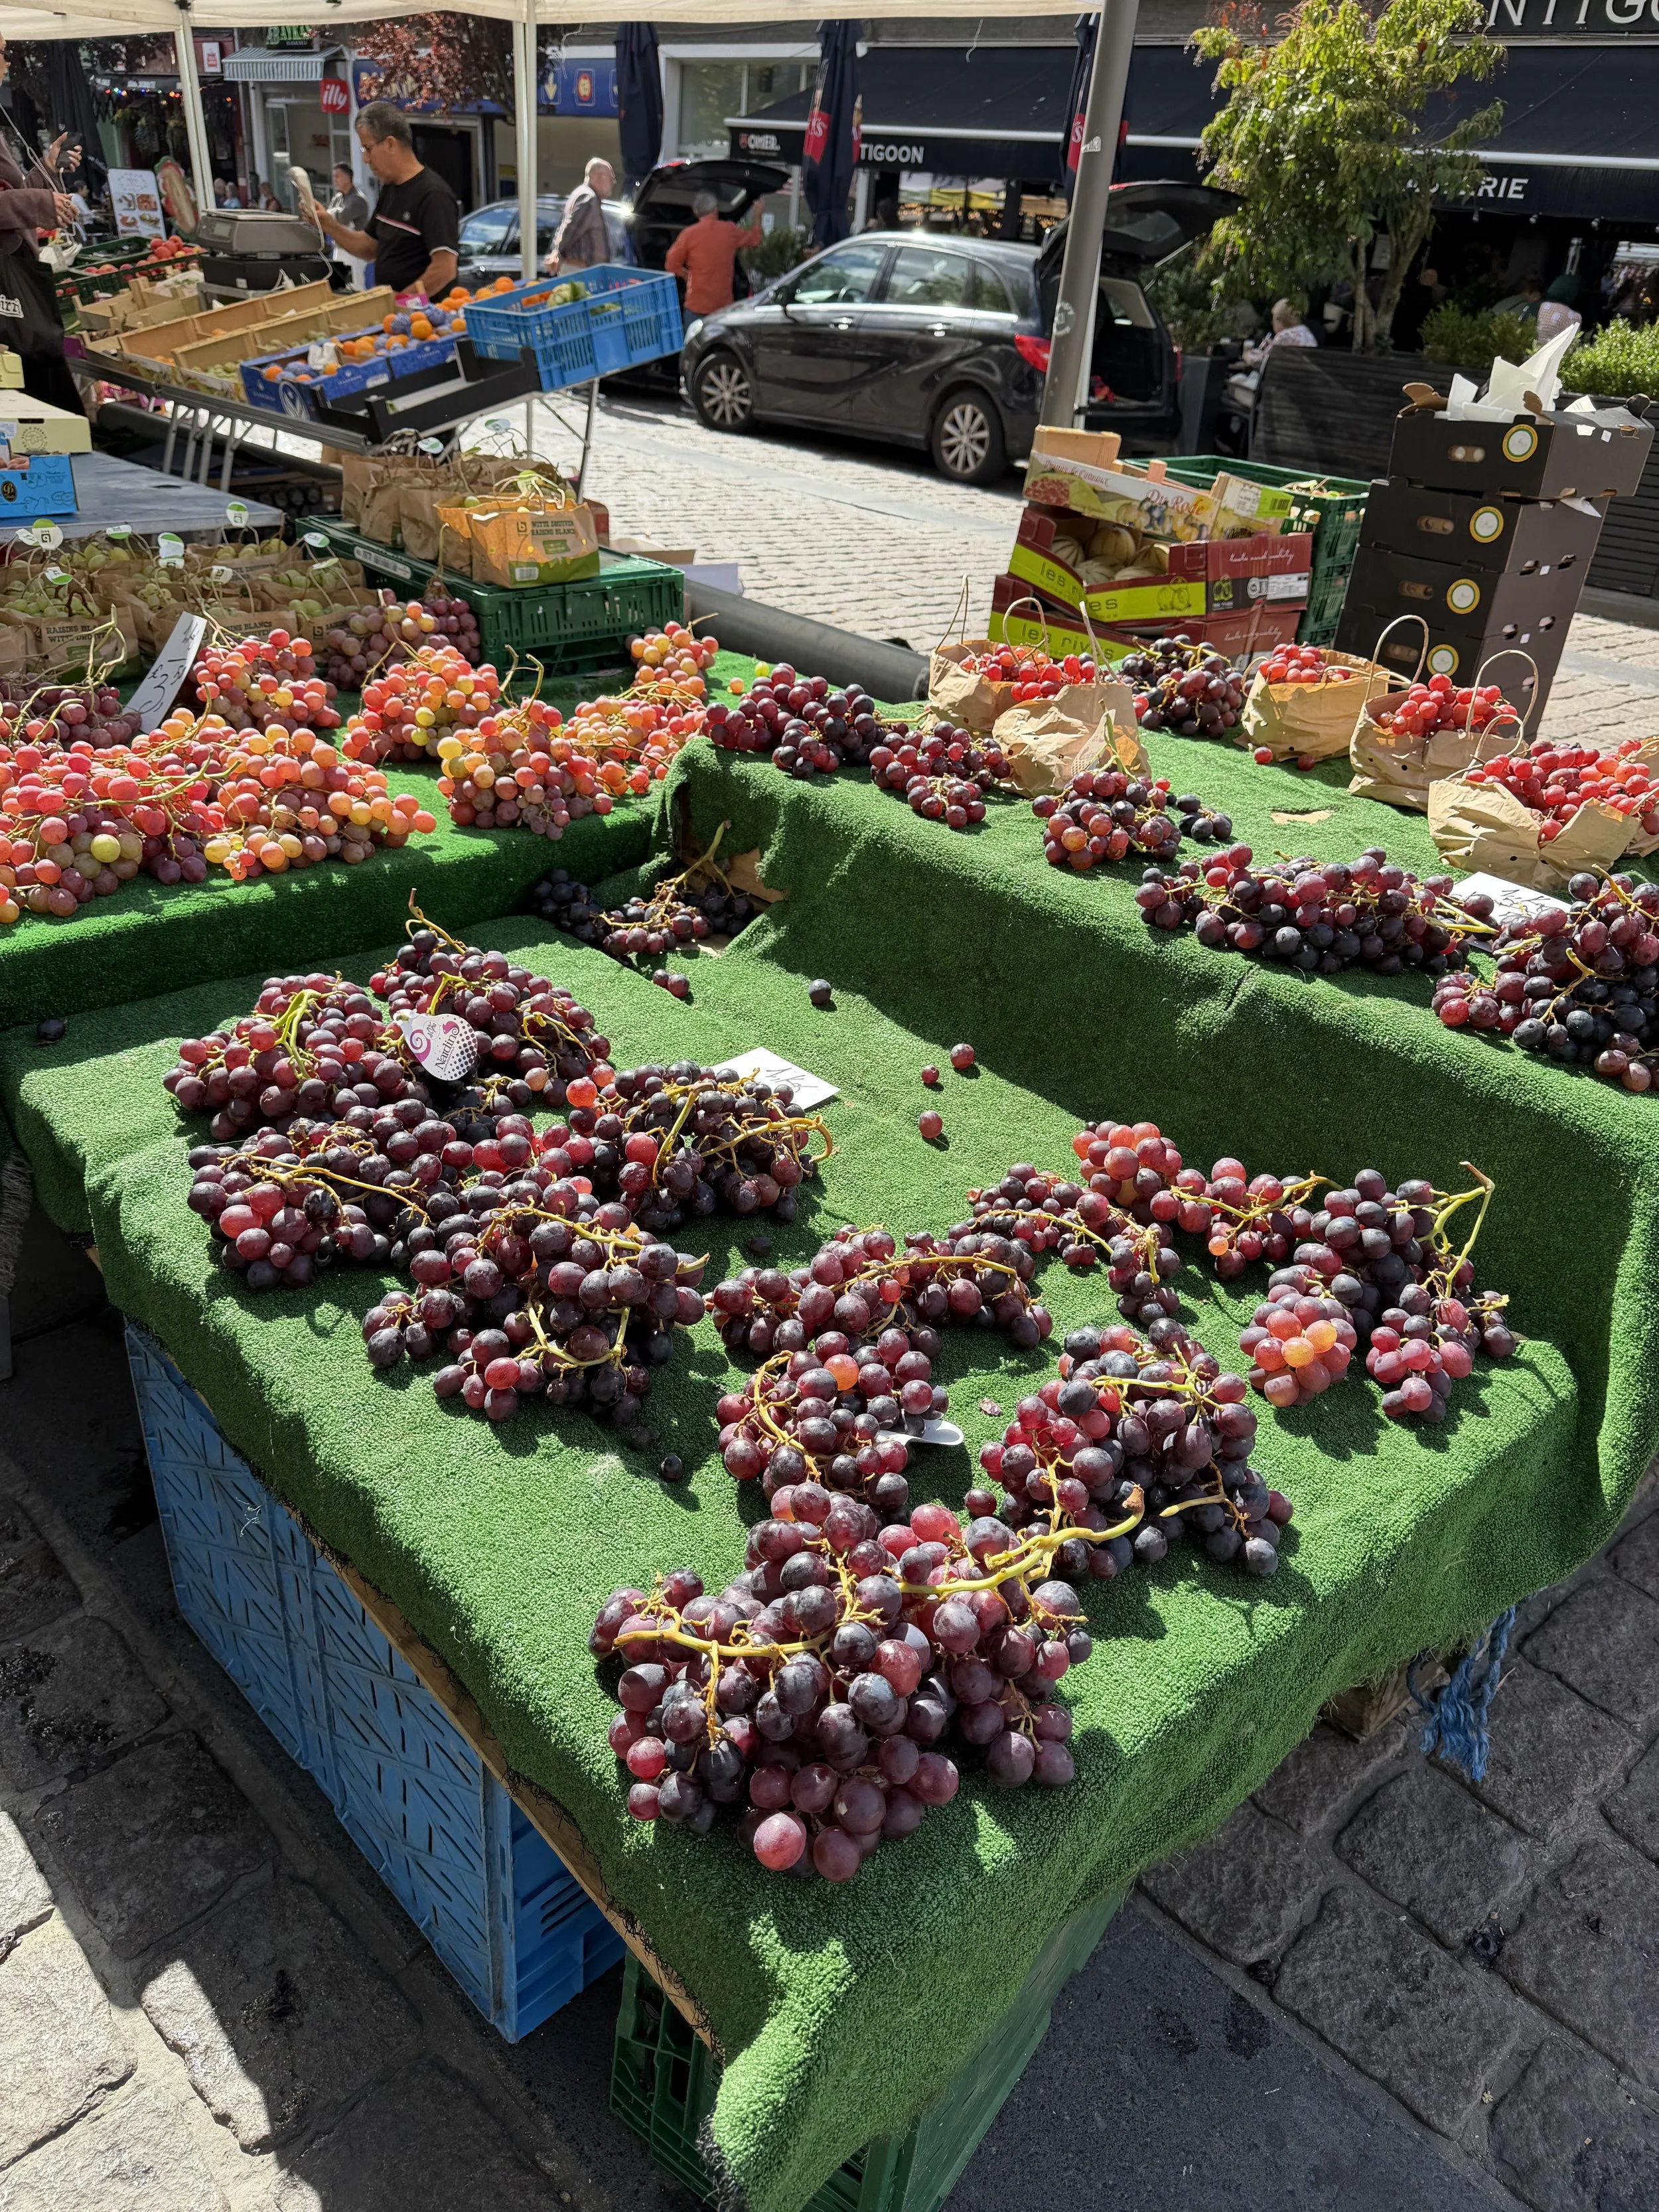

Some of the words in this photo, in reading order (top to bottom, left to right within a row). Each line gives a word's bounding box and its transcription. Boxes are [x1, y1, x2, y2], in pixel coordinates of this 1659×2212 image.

[323, 84, 347, 111] illy
[859, 143, 924, 164] TIGOON
[1041, 562, 1066, 587] les
[46, 625, 78, 634] RAISINS
[244, 621, 273, 630] BLANCS
[1062, 635, 1115, 660] rivs
